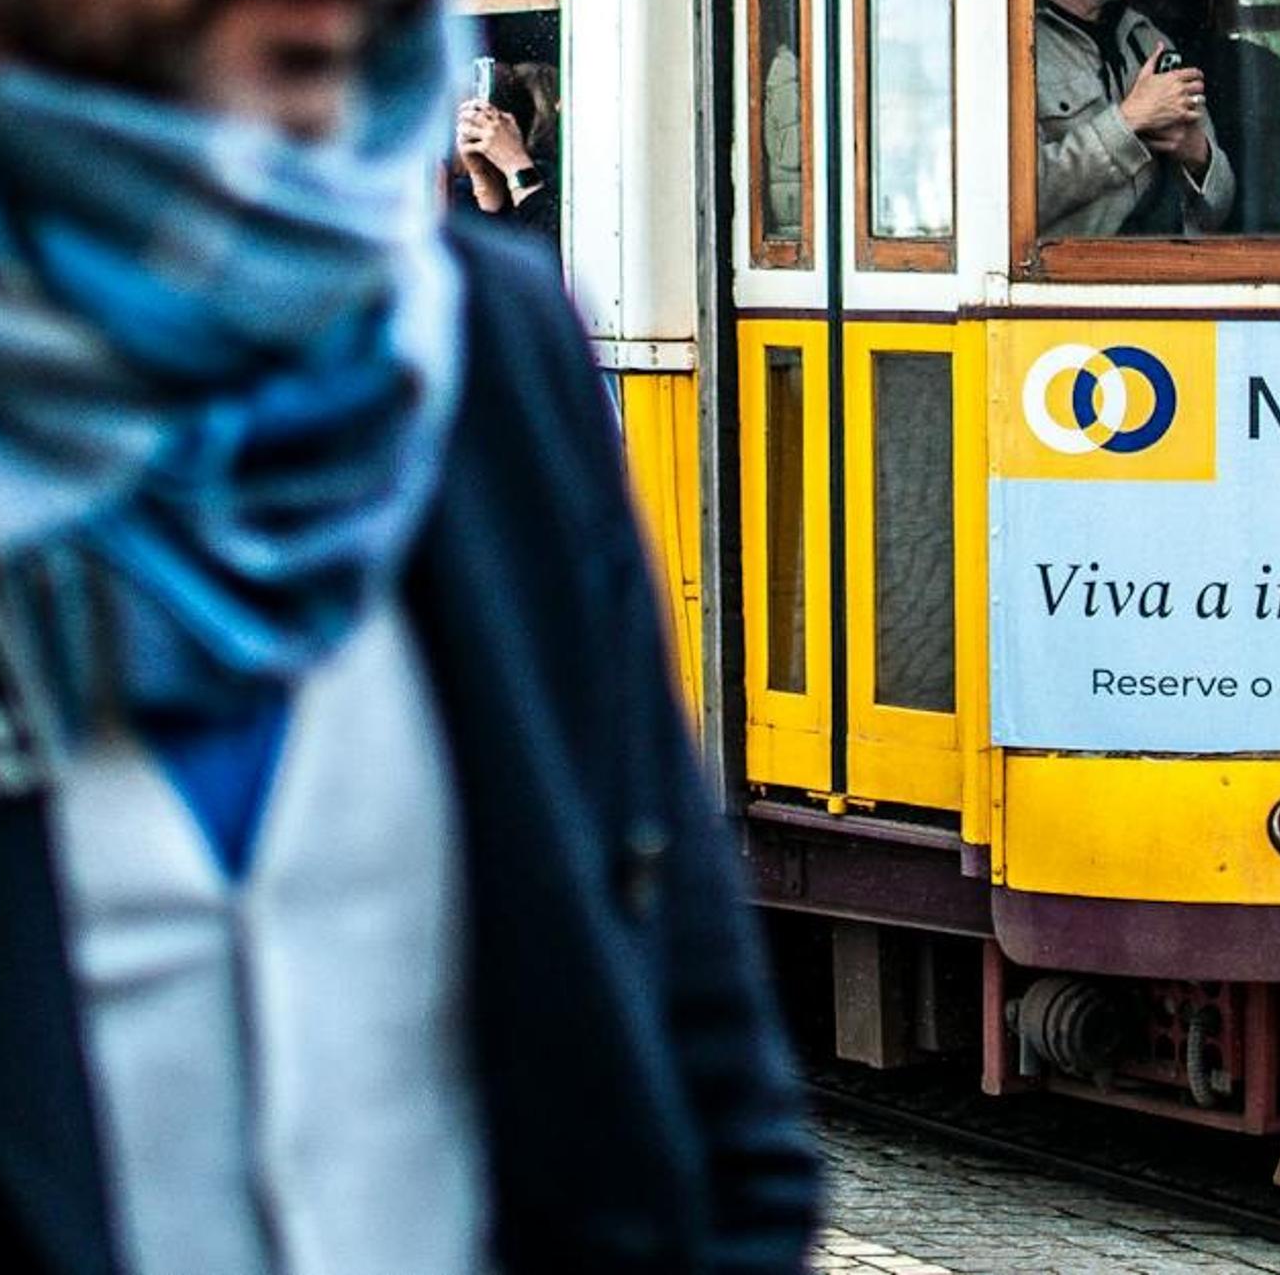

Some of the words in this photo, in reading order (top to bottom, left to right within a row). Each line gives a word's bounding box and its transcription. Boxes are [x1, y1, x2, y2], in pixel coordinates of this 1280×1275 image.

[1036, 562, 1174, 620] Viva
[1195, 578, 1232, 620] a
[1092, 668, 1243, 698] Reserve
[1250, 676, 1273, 698] o
